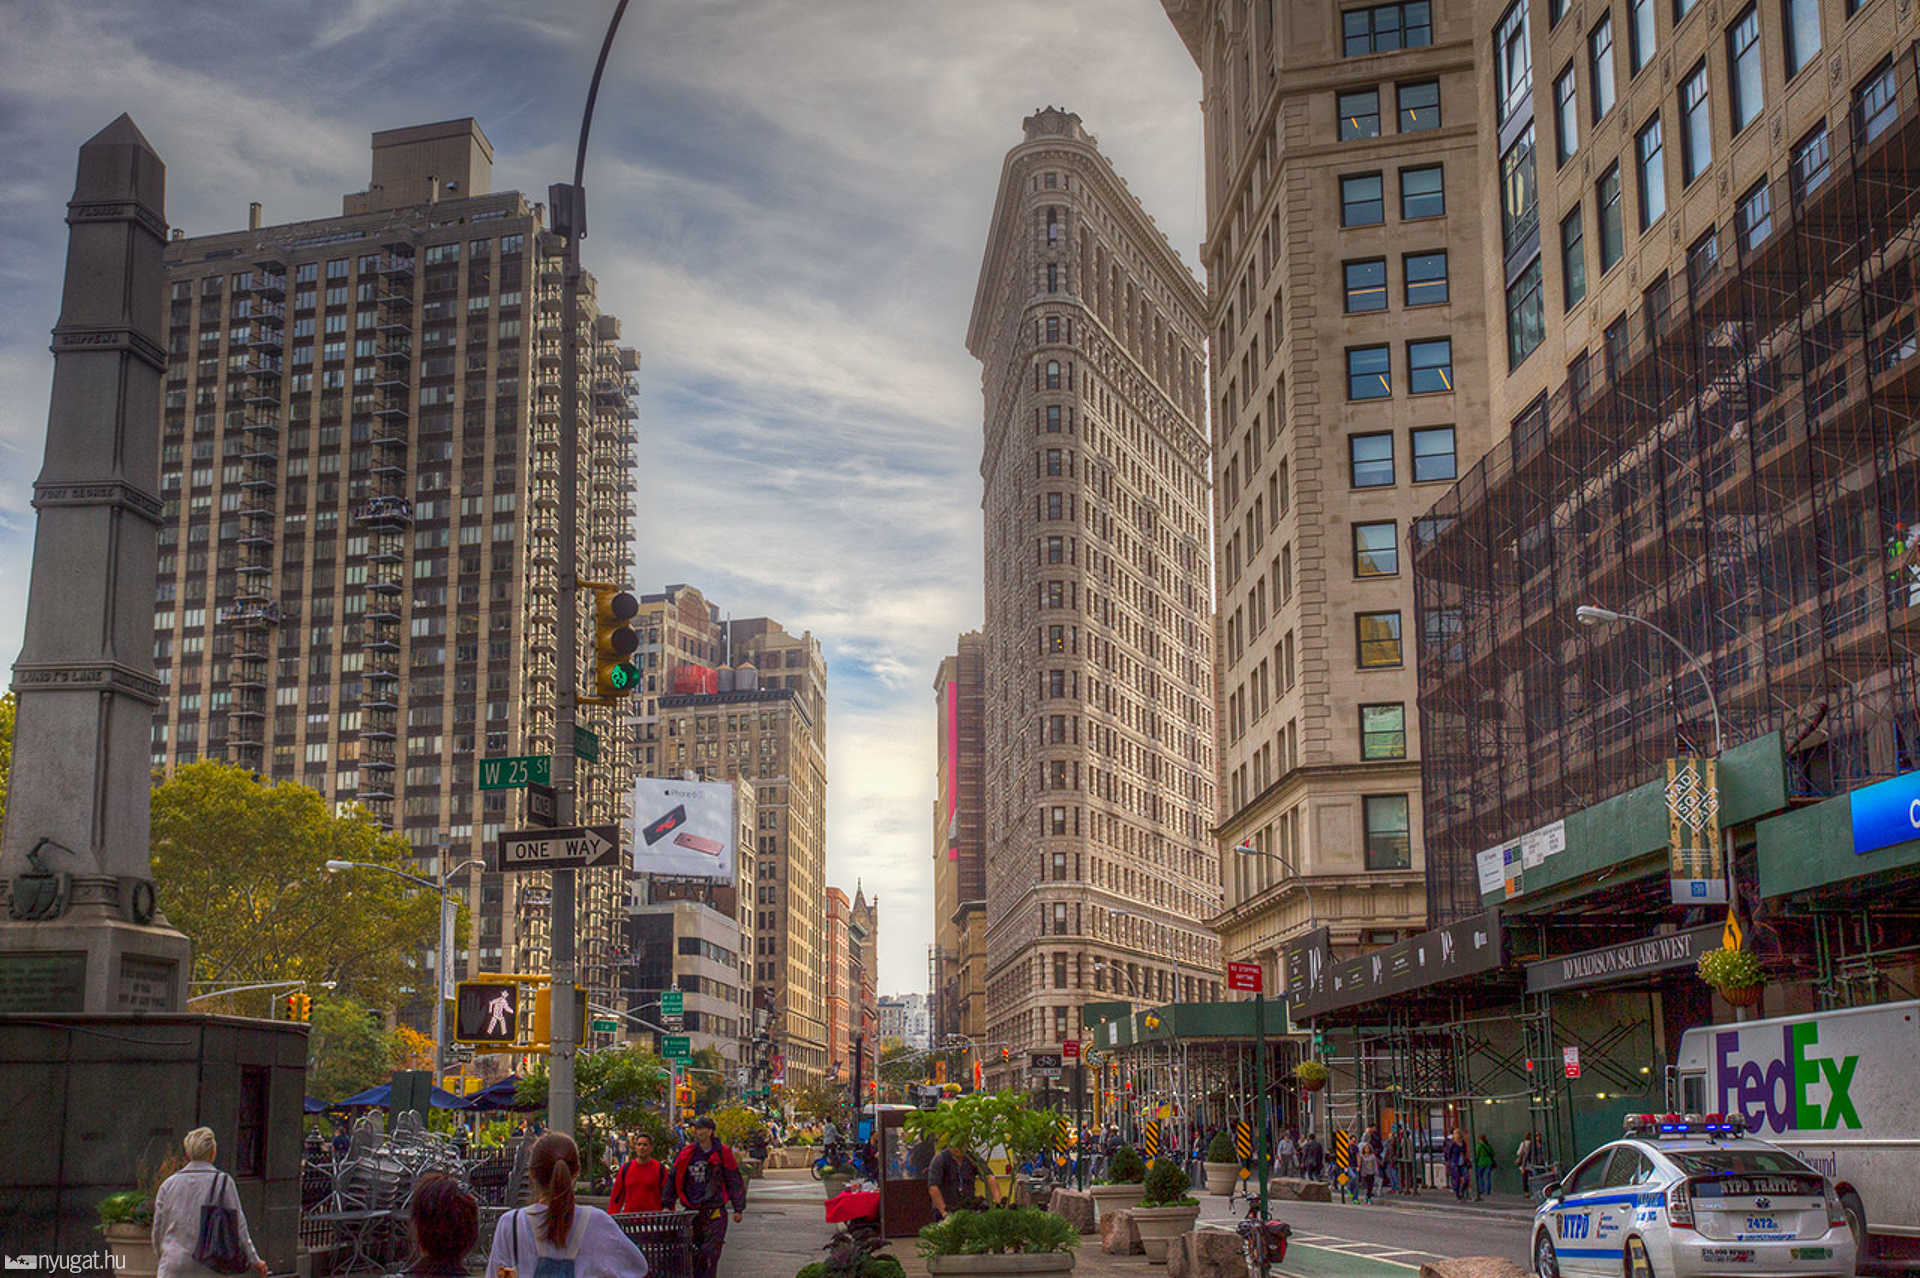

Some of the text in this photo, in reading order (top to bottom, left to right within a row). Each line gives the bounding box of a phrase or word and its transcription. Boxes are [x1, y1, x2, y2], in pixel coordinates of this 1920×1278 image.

[485, 762, 501, 785] W
[508, 760, 528, 784] 25
[515, 838, 600, 859] ONE WAY
[1573, 948, 1617, 979] MADISON
[1618, 940, 1659, 971] SQUARE
[1659, 933, 1693, 961] WEST
[1716, 1021, 1863, 1134] FedEx
[1720, 1178, 1799, 1194] NYPD TRAFFIC
[1562, 1213, 1590, 1240] NYPD
